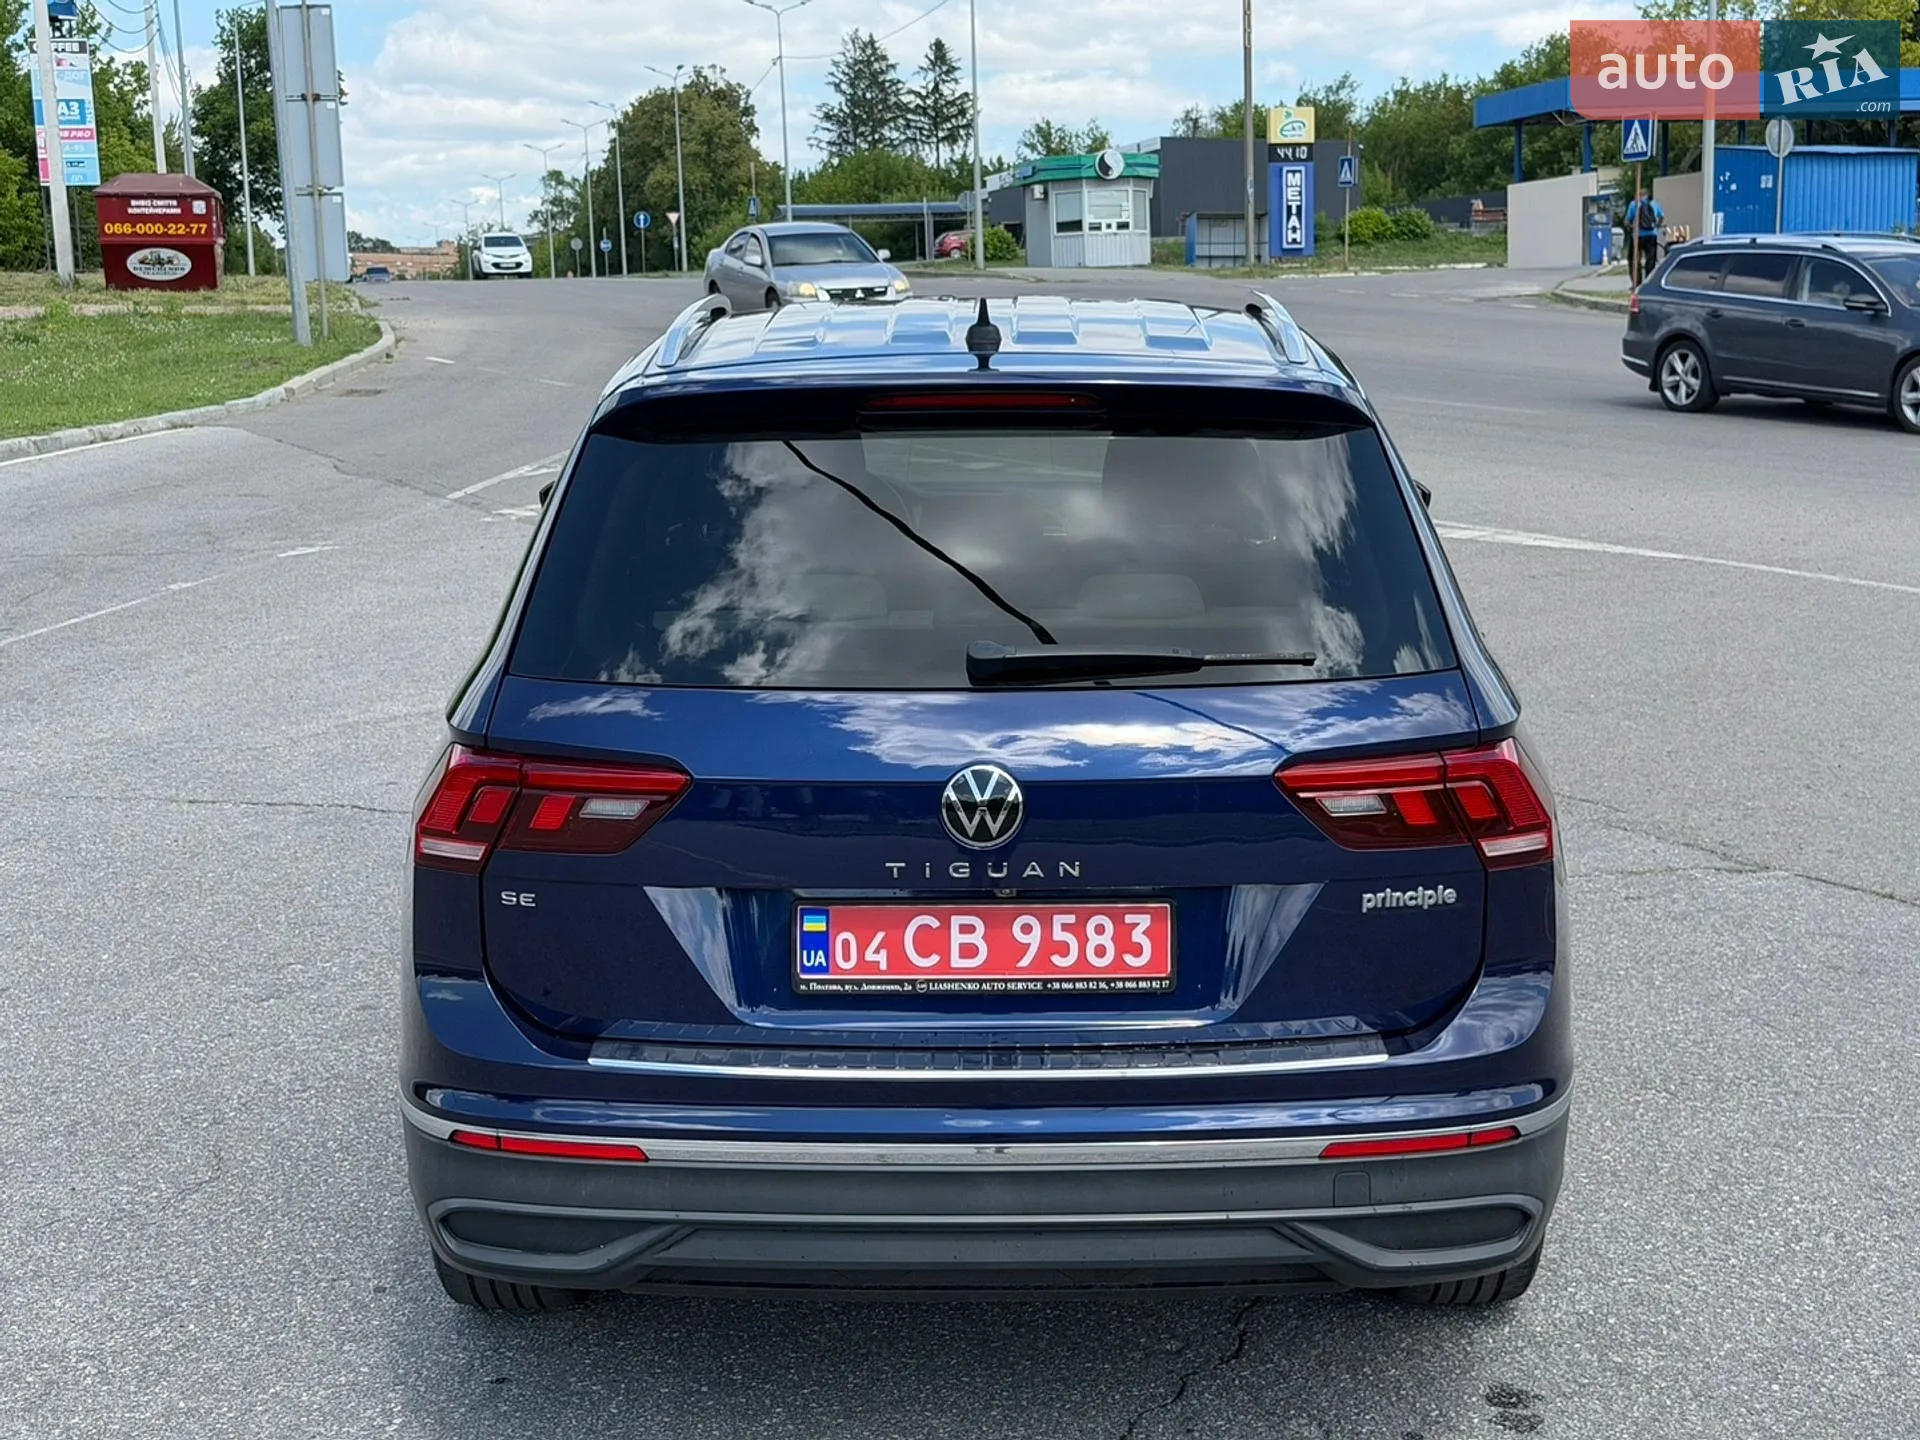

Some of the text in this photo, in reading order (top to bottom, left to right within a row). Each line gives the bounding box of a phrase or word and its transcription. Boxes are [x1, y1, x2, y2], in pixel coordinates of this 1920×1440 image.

[104, 223, 208, 235] 066-000-22-77
[501, 891, 536, 907] SE
[1362, 885, 1458, 913] principle
[834, 931, 888, 970] 04
[1011, 914, 1152, 968] 9583
[803, 950, 827, 967] UA
[929, 982, 979, 991] LIASHENKO
[982, 982, 1005, 991] AUTO
[1007, 982, 1043, 990] SERVICE
